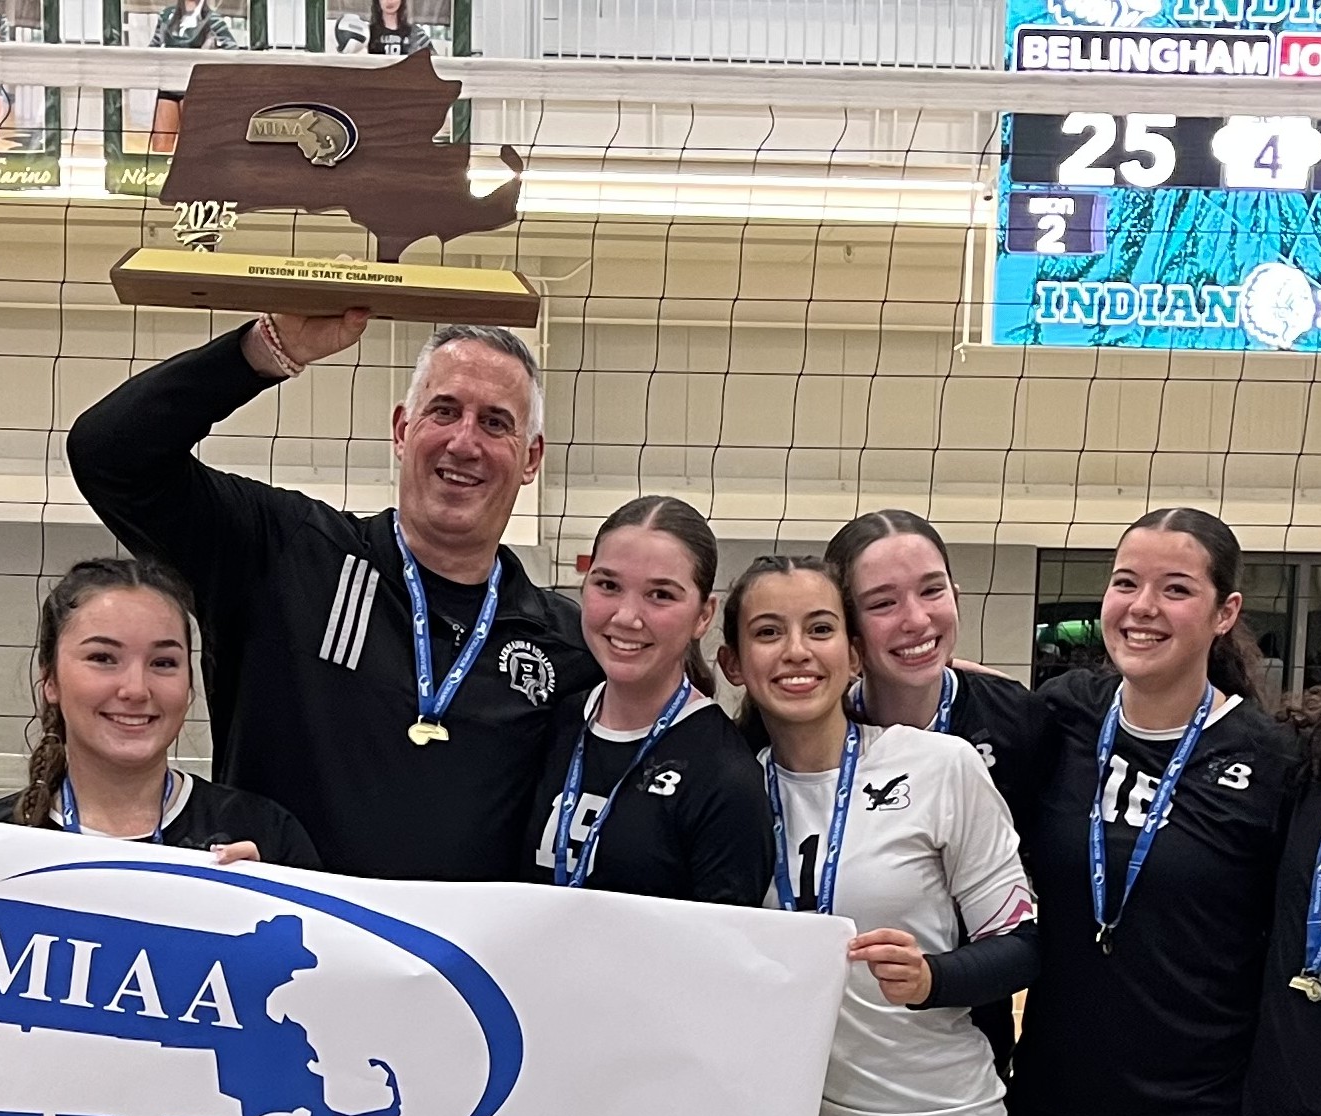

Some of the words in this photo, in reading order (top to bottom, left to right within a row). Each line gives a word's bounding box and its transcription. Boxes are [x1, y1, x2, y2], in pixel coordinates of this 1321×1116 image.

[1022, 36, 1270, 76] BELLINGHAM
[252, 120, 305, 136] MIAA
[1058, 112, 1177, 187] 25
[1254, 135, 1283, 179] 4
[172, 200, 239, 232] 2025
[1035, 214, 1067, 254] 2
[248, 265, 295, 277] DIVISION
[297, 269, 309, 278] III
[311, 270, 343, 280] STATE
[345, 272, 403, 284] CHAMPION
[1034, 280, 1246, 328] INDIAN
[459, 637, 480, 668] CHAMPION
[433, 681, 454, 714] CHAMPION
[1218, 762, 1253, 790] B
[832, 810, 844, 846] CHAMPION
[793, 834, 821, 911] 1
[821, 867, 833, 905] CHAMPION
